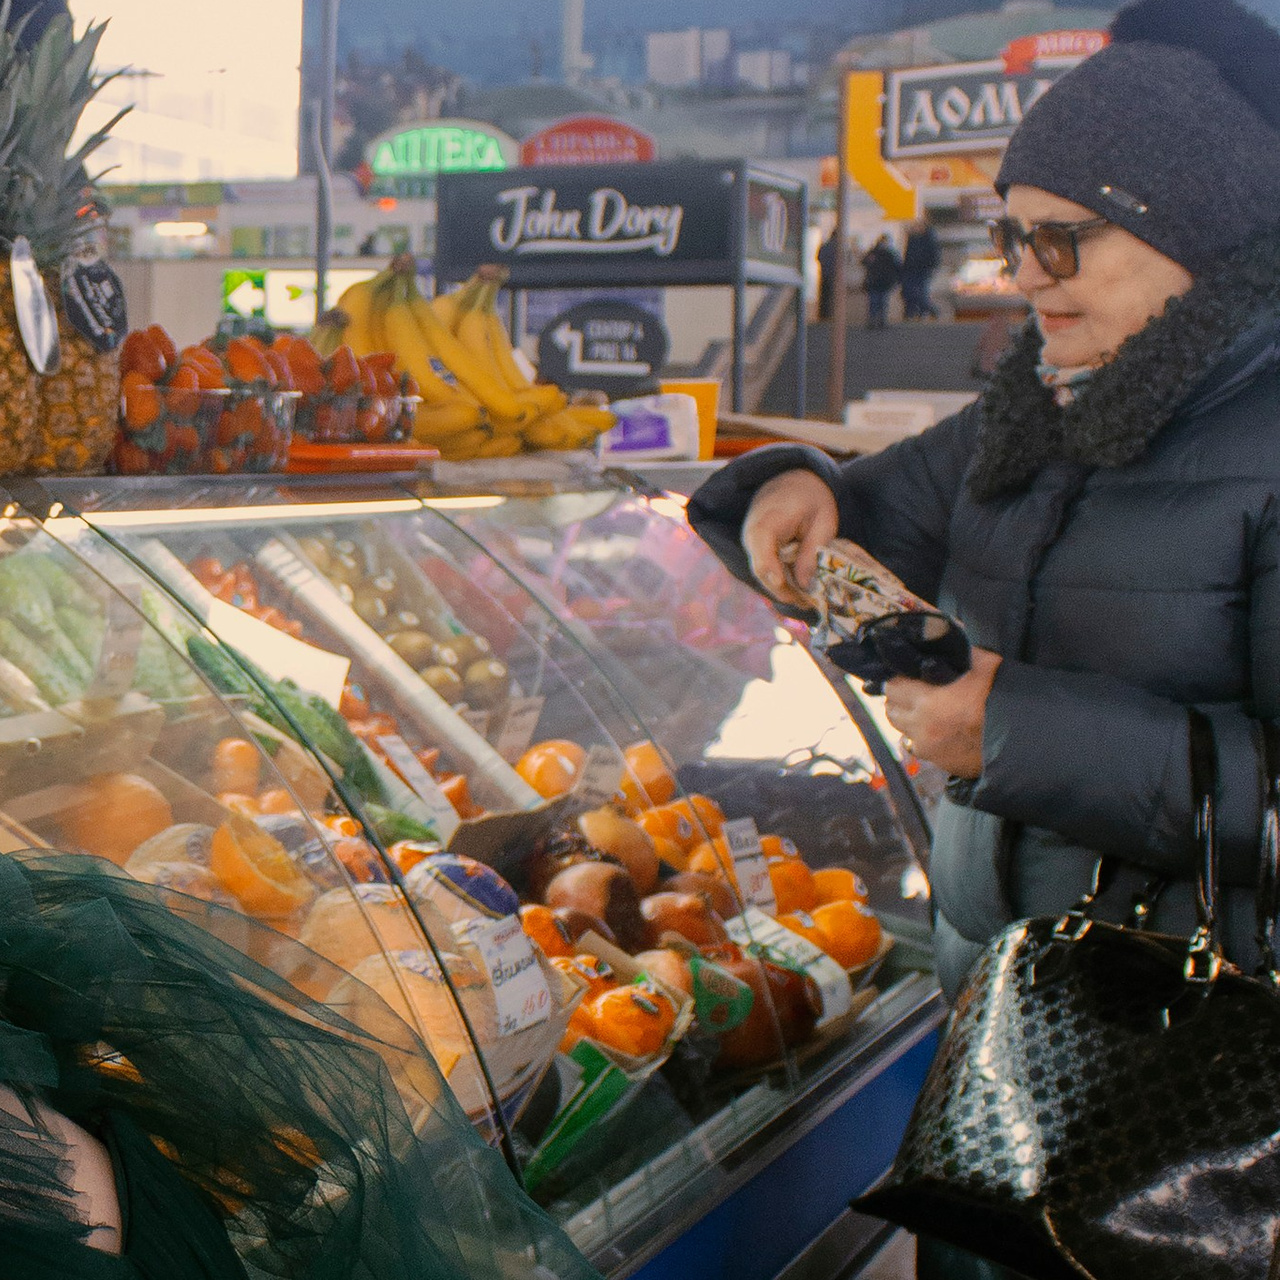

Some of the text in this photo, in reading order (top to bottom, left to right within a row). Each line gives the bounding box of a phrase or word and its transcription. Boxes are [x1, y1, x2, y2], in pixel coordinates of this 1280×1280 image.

[373, 126, 506, 174] АПТЕКА
[491, 187, 683, 257] John Dory
